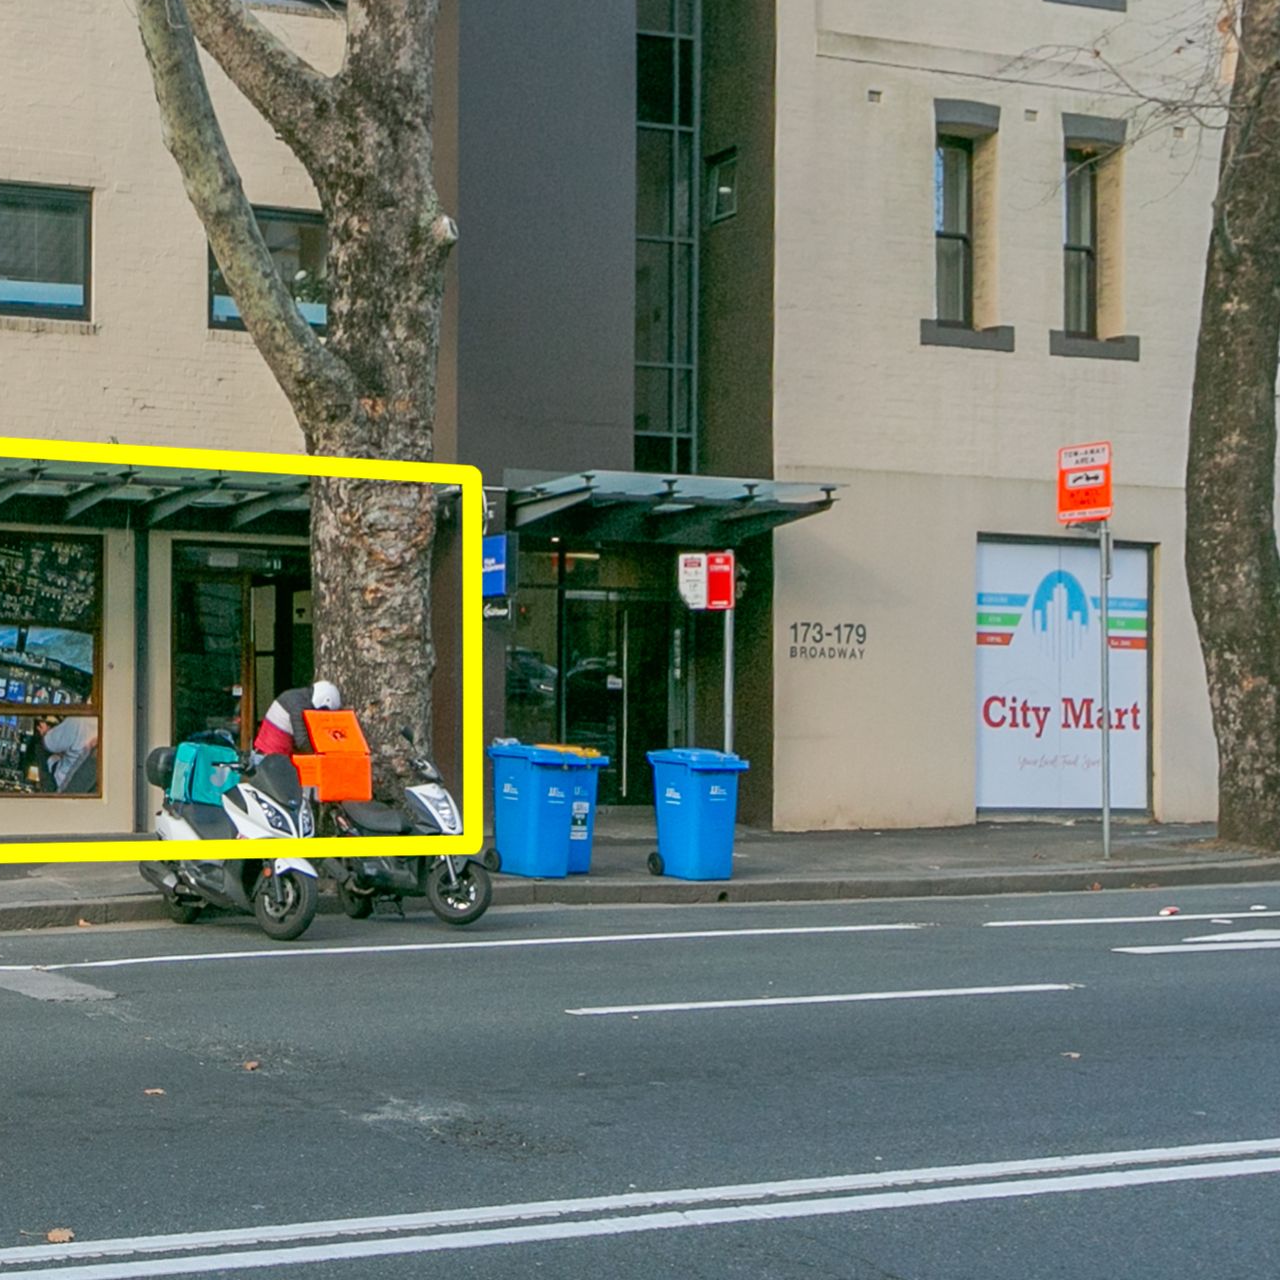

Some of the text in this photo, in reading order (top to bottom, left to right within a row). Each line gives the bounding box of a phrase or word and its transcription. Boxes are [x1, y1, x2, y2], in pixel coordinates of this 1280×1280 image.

[790, 622, 867, 645] 173-179
[789, 646, 865, 659] BROADWAY
[982, 695, 1141, 739] City Mart
